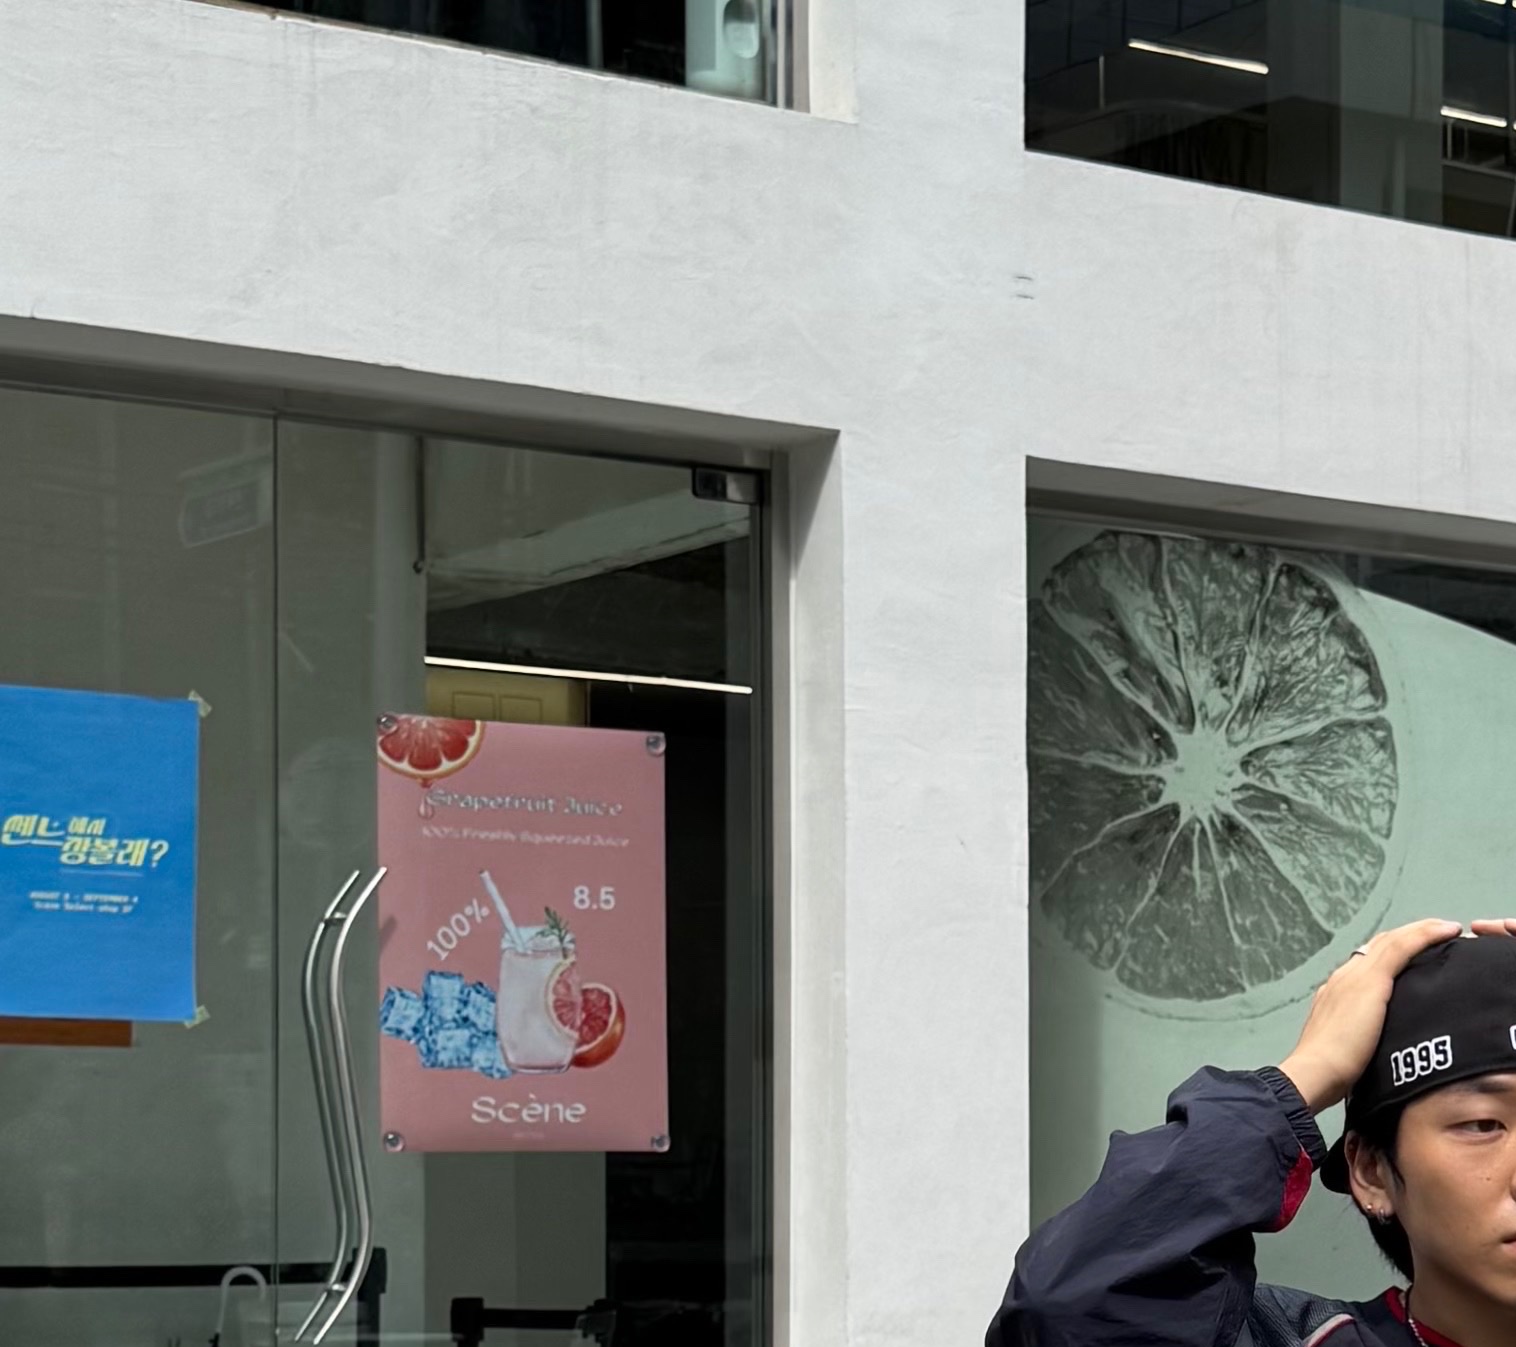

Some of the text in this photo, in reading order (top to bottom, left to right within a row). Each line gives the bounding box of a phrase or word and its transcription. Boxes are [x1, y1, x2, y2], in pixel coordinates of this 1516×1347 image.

[564, 796, 622, 816] Juice
[573, 885, 616, 911] 8.5
[427, 898, 490, 960] 100%
[1390, 1035, 1453, 1086] 1995
[471, 1093, 587, 1124] Scène
